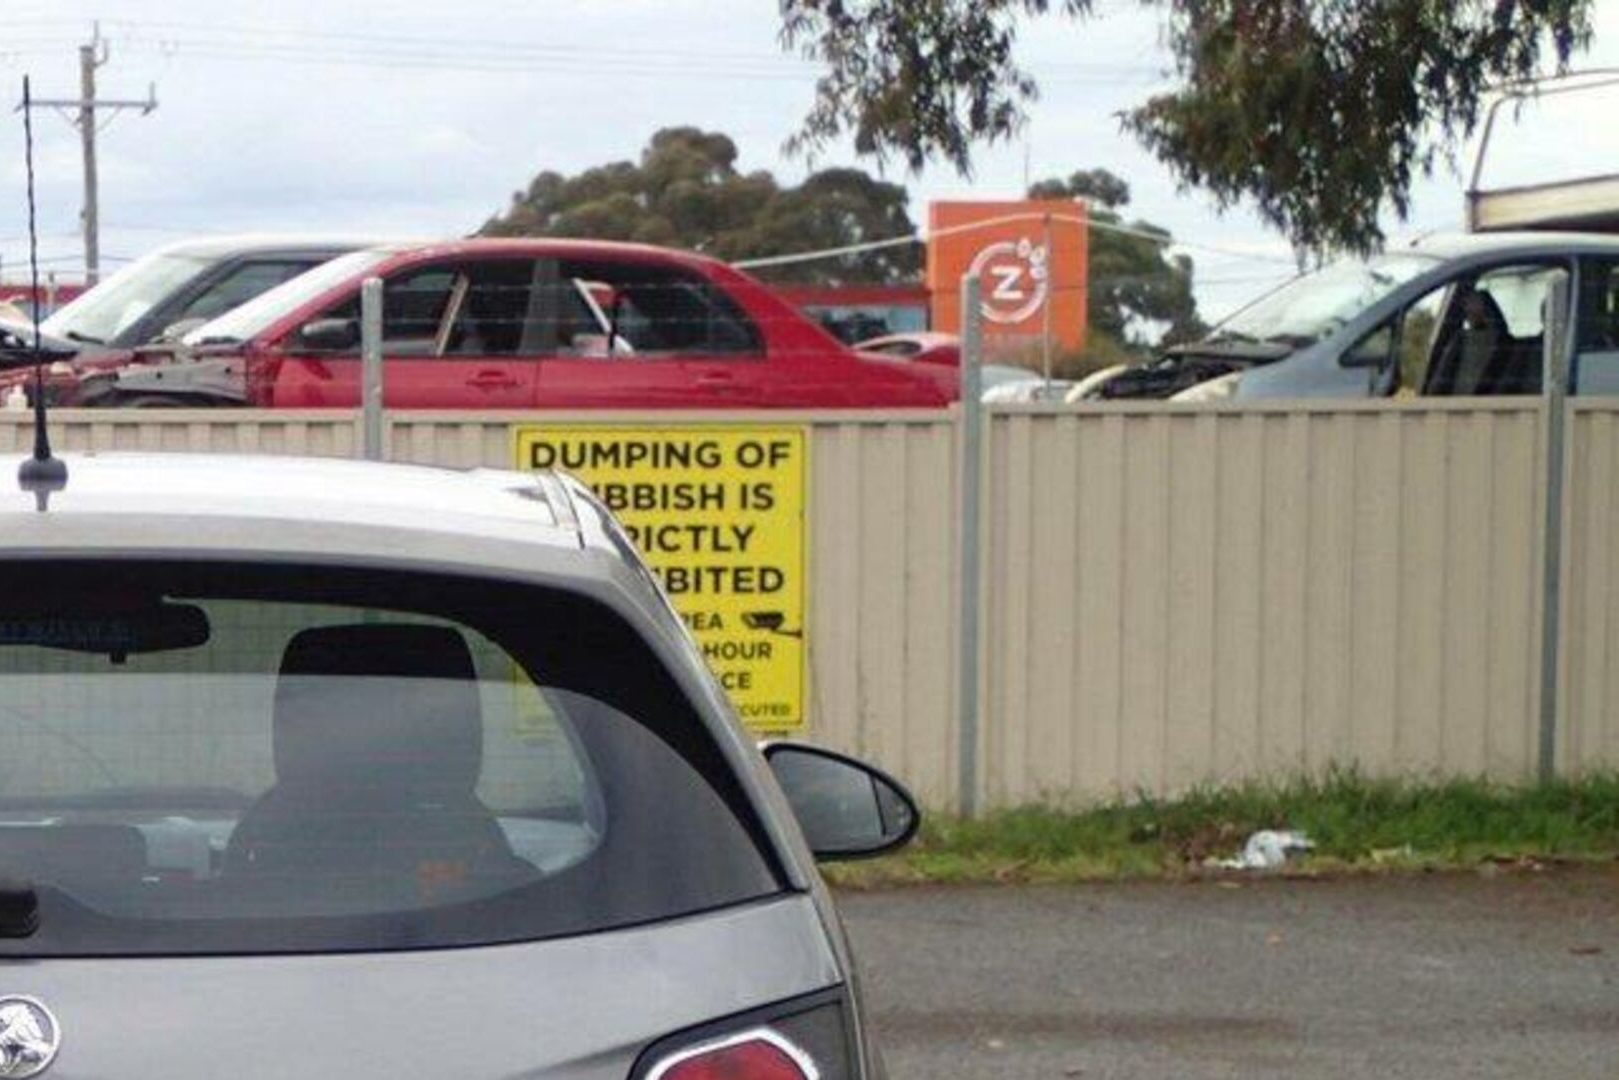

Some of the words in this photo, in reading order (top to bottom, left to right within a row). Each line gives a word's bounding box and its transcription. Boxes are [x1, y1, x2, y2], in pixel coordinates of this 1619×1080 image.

[530, 441, 722, 469] DUMPING
[736, 441, 791, 469] OF
[595, 483, 725, 511] BBISH
[740, 483, 774, 511] IS
